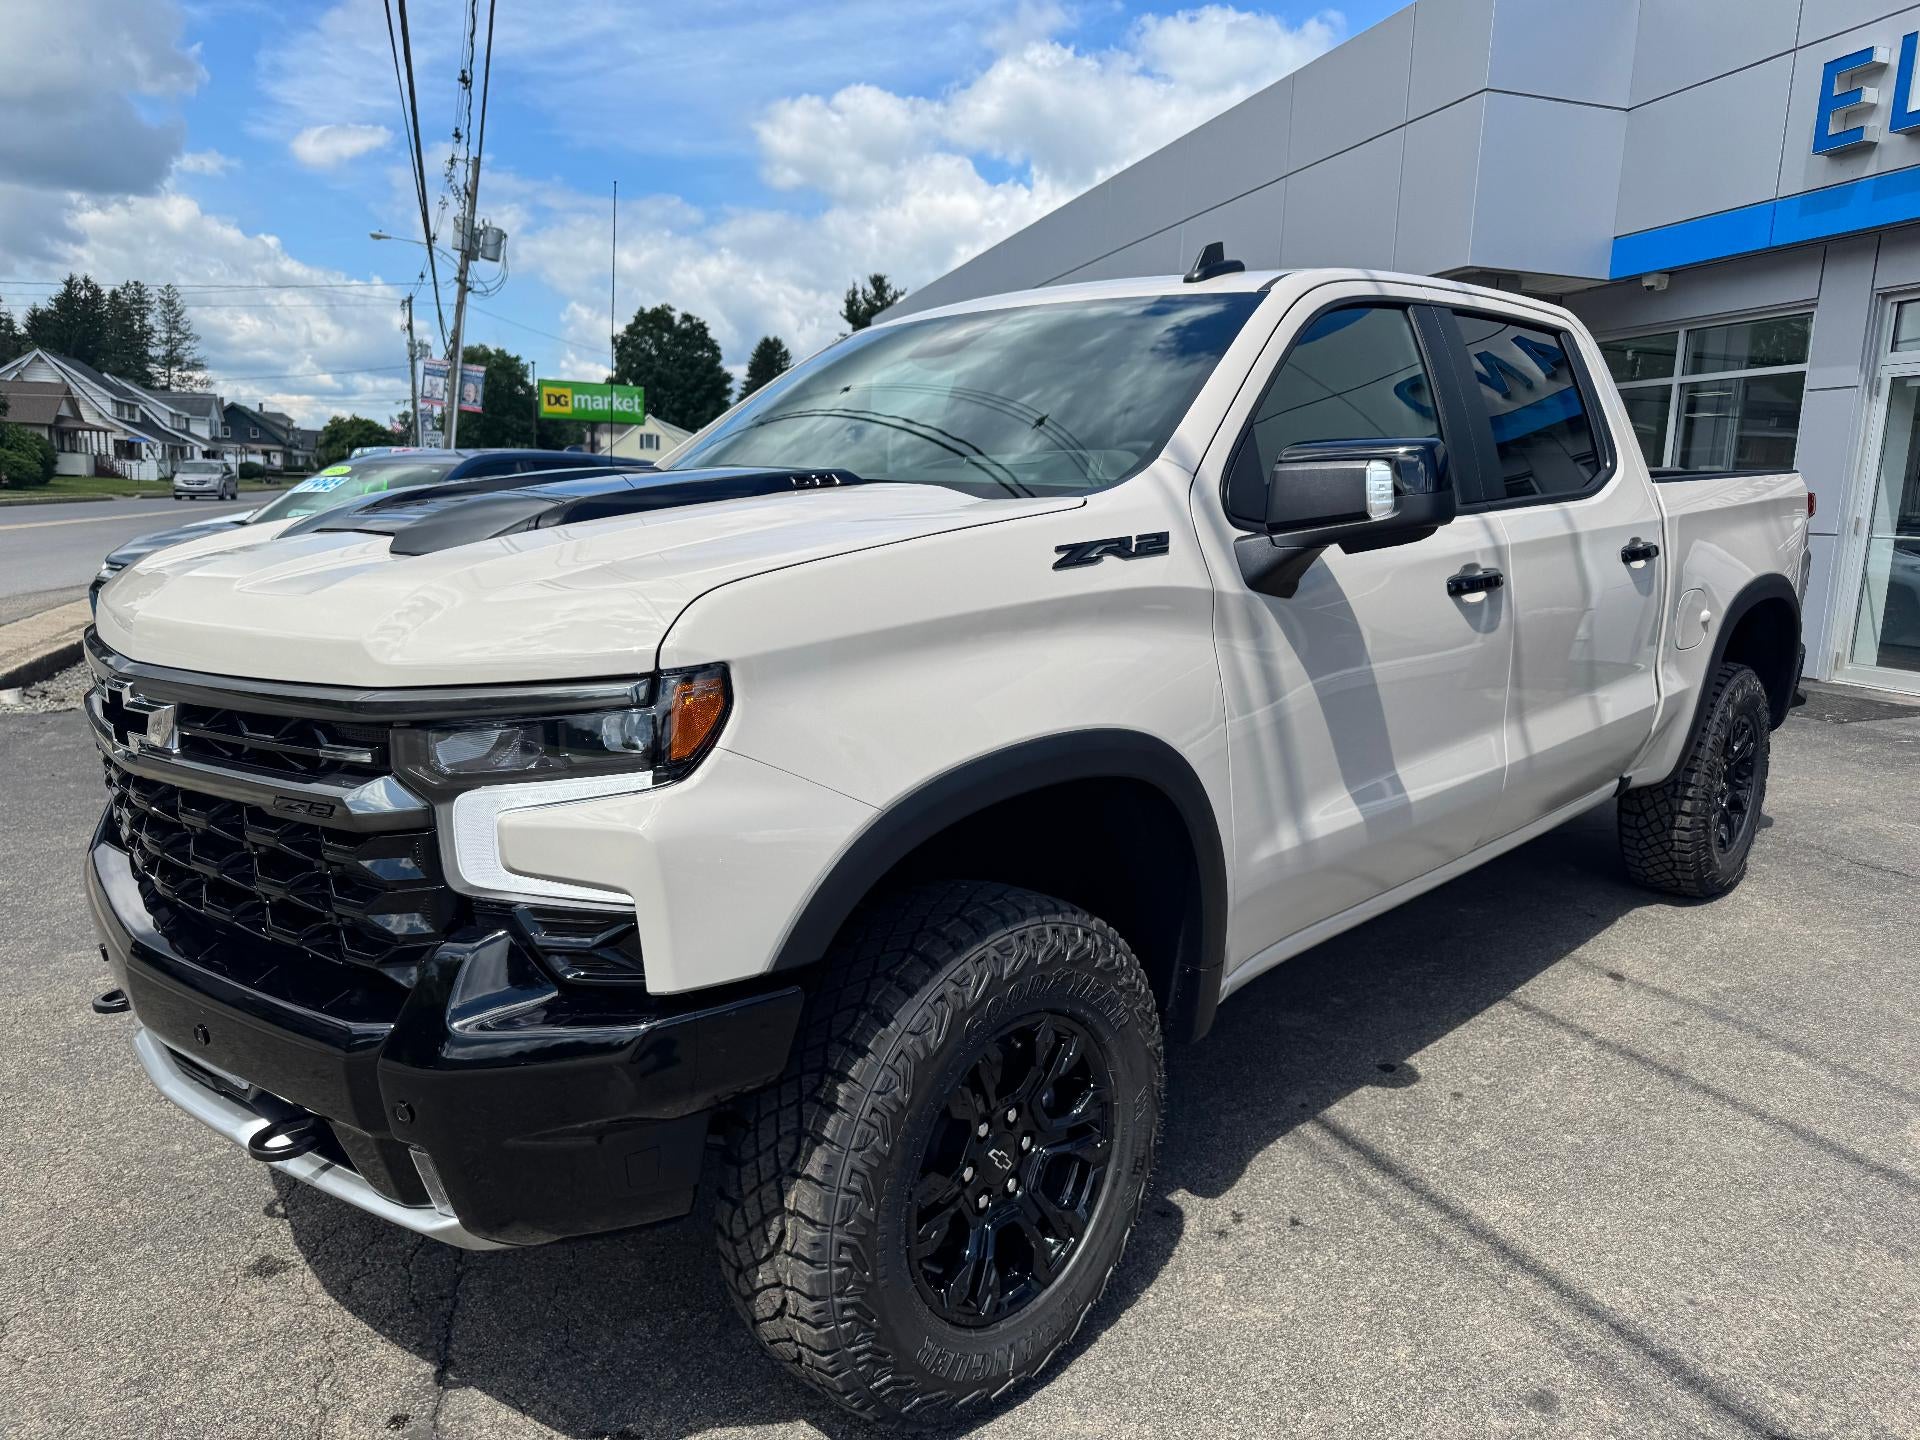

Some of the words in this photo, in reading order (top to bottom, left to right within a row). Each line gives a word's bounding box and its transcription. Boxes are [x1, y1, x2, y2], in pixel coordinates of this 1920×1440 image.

[546, 393, 570, 407] DG
[573, 391, 641, 412] market
[1052, 531, 1170, 571] ZR2
[273, 795, 337, 819] ZR2
[964, 967, 1130, 1038] GOODYEAR
